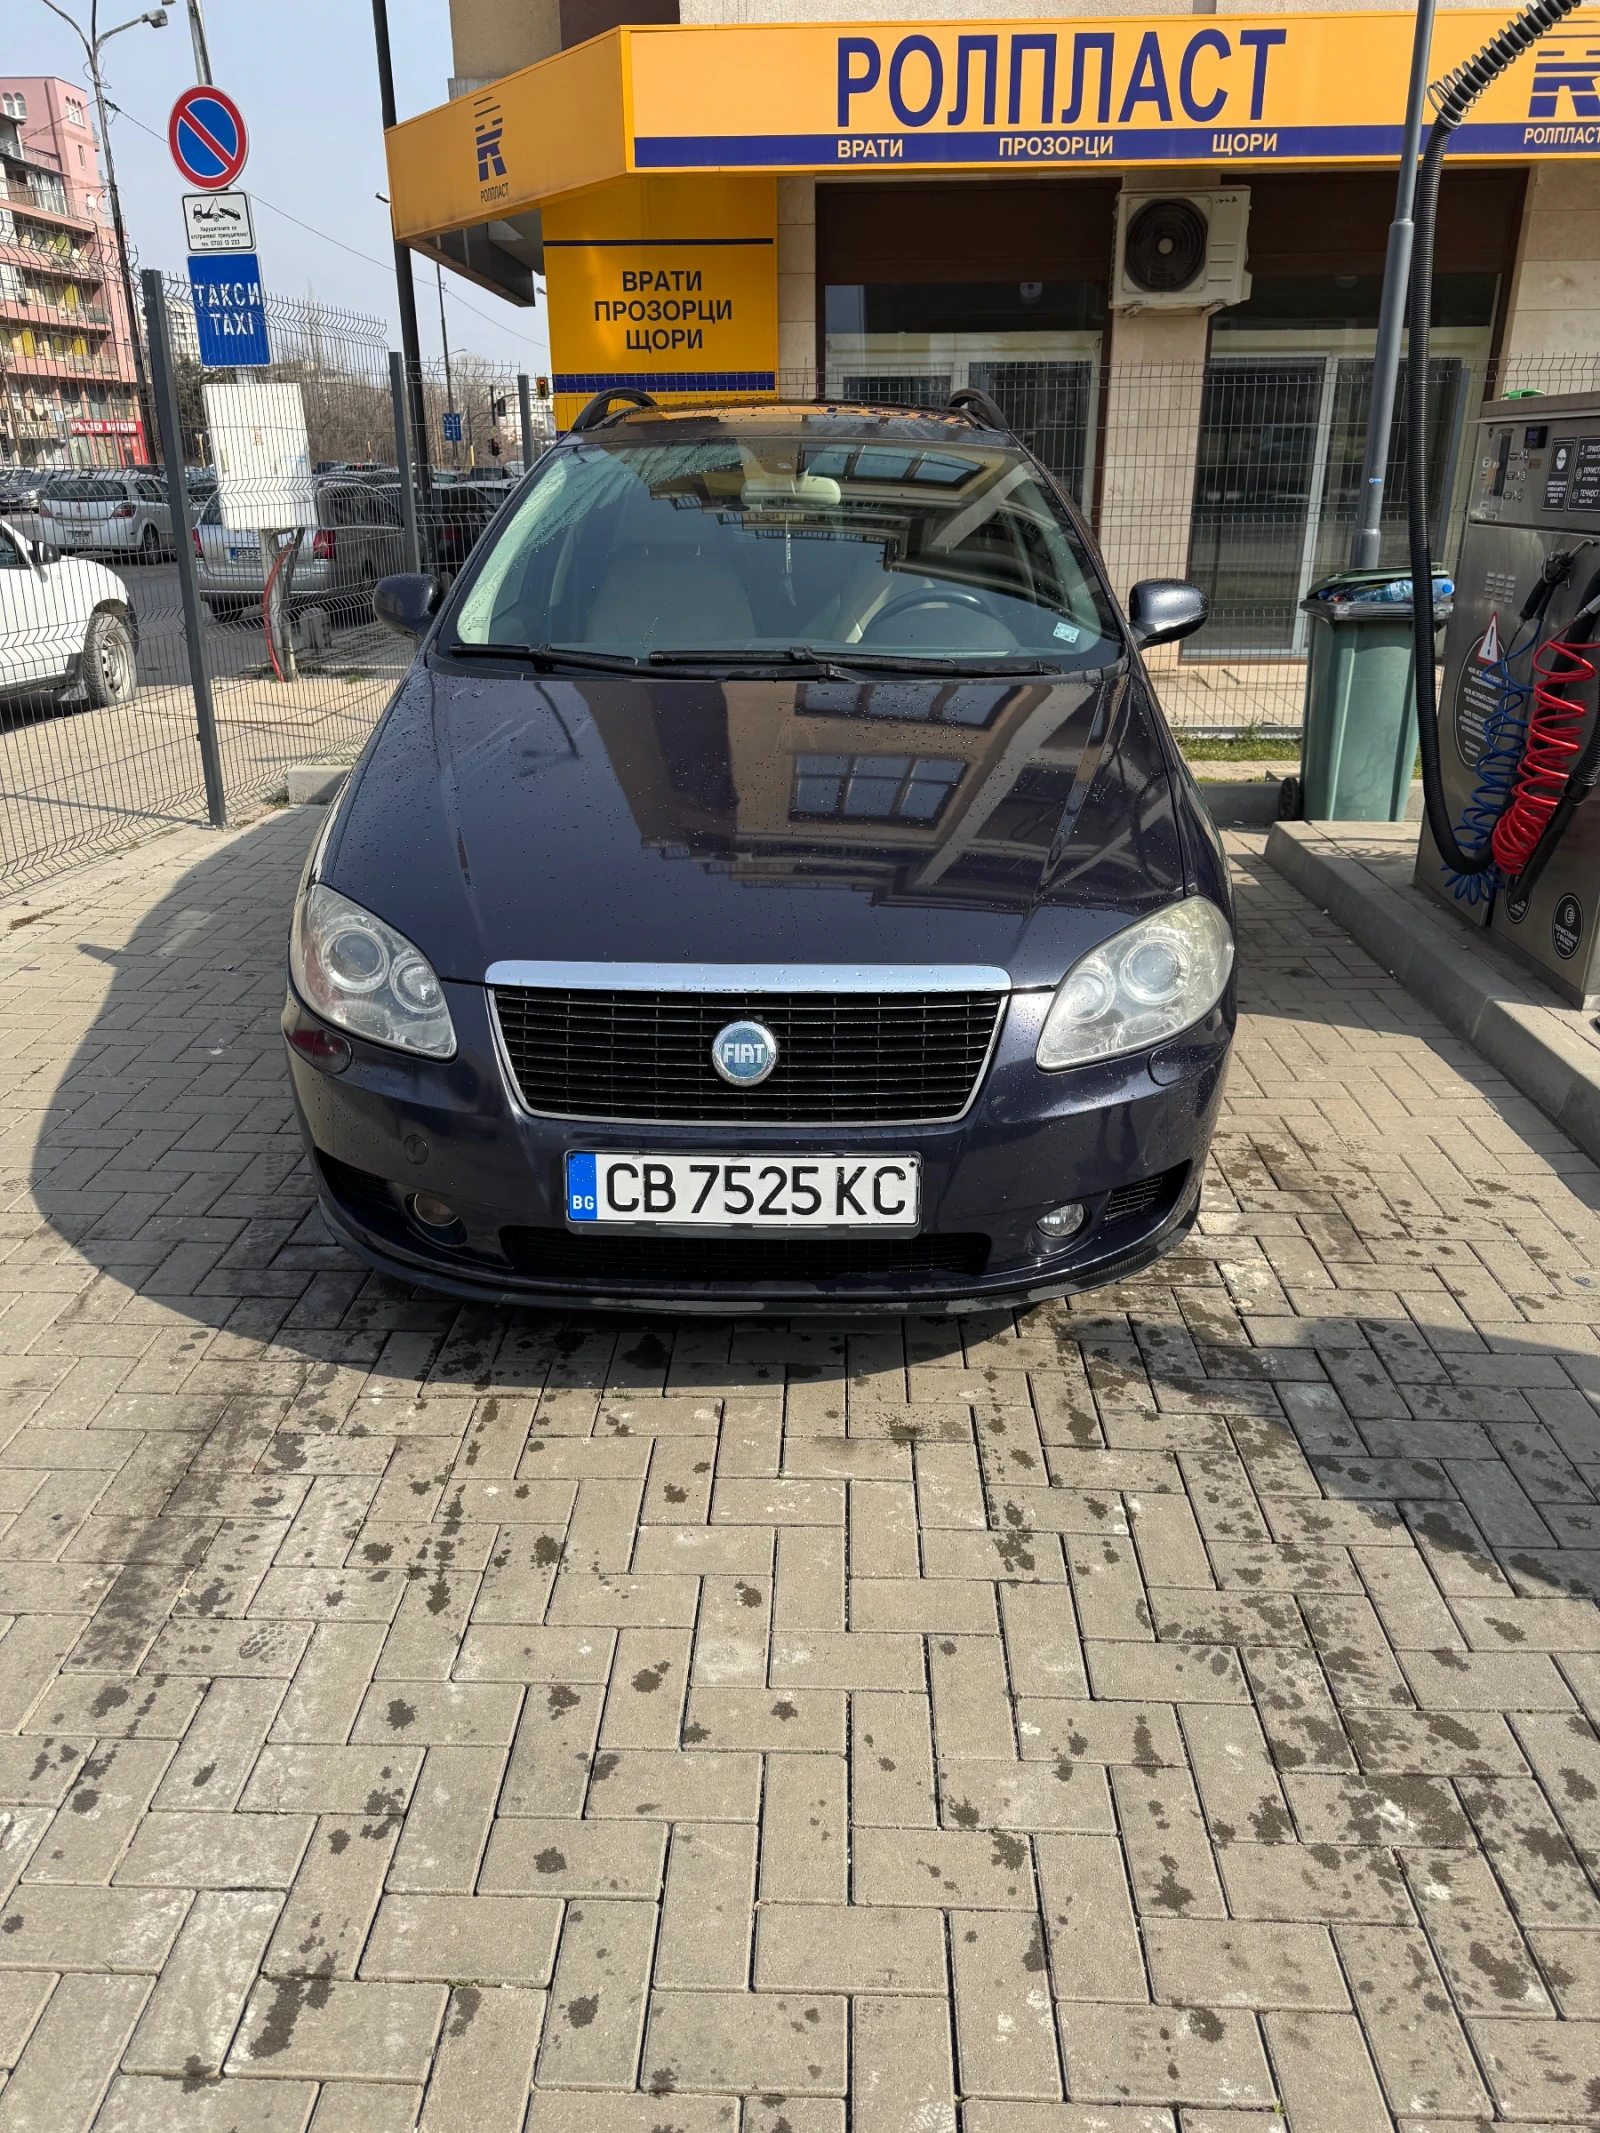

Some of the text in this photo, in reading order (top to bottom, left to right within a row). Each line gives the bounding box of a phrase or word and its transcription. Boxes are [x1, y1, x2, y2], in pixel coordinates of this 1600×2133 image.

[837, 29, 1287, 128] РОЛПЛАСТ
[837, 138, 904, 159] ВРАТИ
[998, 135, 1115, 159] ПРОЗОРЦИ
[1211, 132, 1279, 155] ЩОРИ
[480, 182, 509, 205] РОЛПЛАСТ
[623, 271, 703, 292] ВРАТИ
[194, 282, 260, 307] ТАКСИ
[209, 312, 253, 335] TAXI
[595, 300, 733, 325] ПРОЗОРЦИ
[626, 328, 704, 354] ЩОРИ
[722, 1043, 765, 1065] FIAT
[606, 1162, 907, 1217] CB 7525 KC
[572, 1195, 594, 1210] BG
